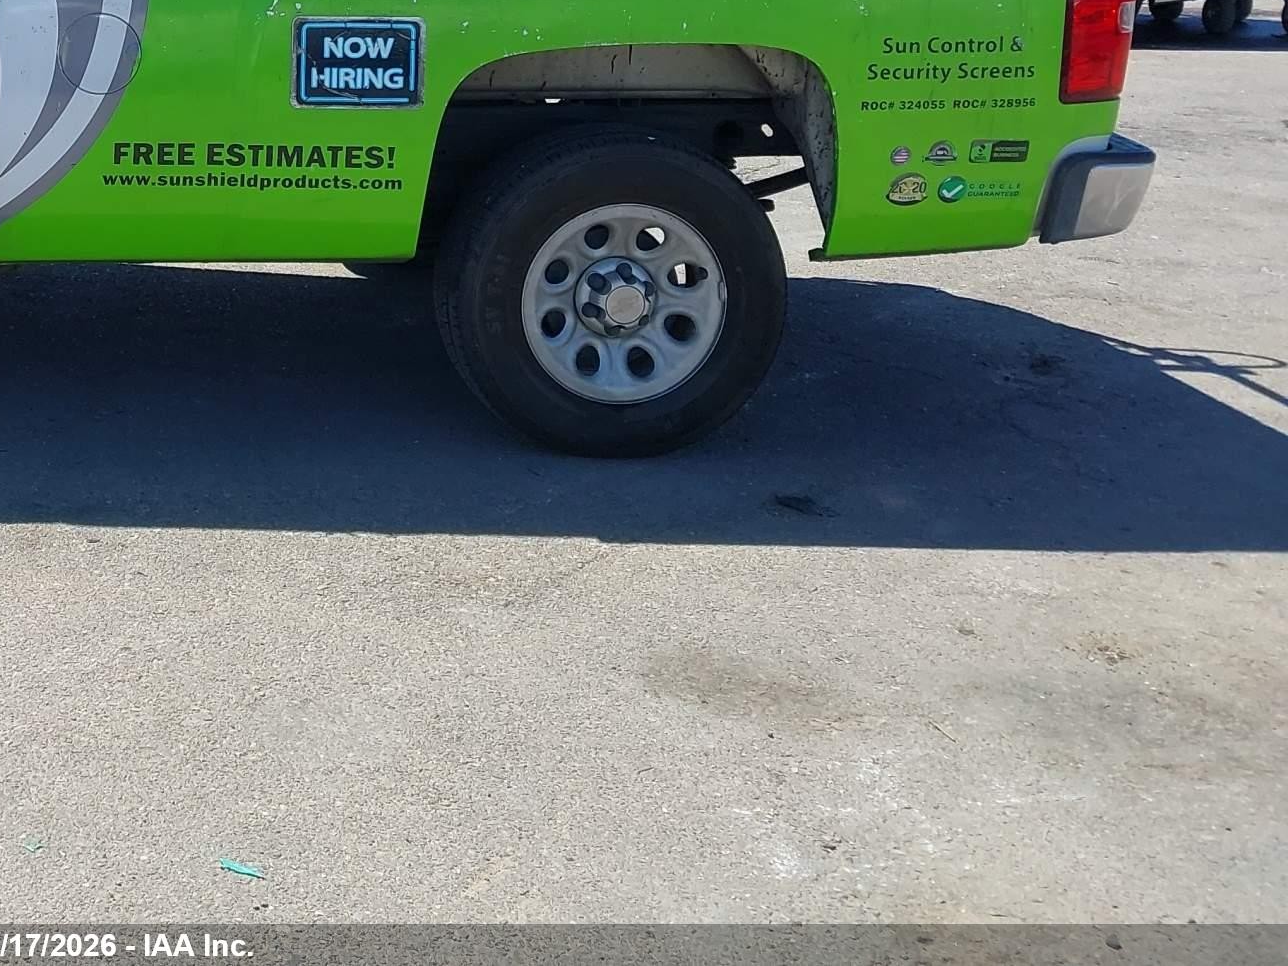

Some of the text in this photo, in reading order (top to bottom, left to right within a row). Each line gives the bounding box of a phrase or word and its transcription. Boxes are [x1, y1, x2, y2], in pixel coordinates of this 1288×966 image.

[323, 37, 394, 59] NOW
[882, 36, 1023, 54] Sun Control &
[311, 67, 404, 90] HIRING
[867, 62, 1035, 84] Security Screens
[861, 97, 1036, 111] ROC# 324055 ROC# 328956
[113, 142, 397, 169] FREE ESTIMATES!
[102, 172, 403, 192] www.sunshieldproducts.com
